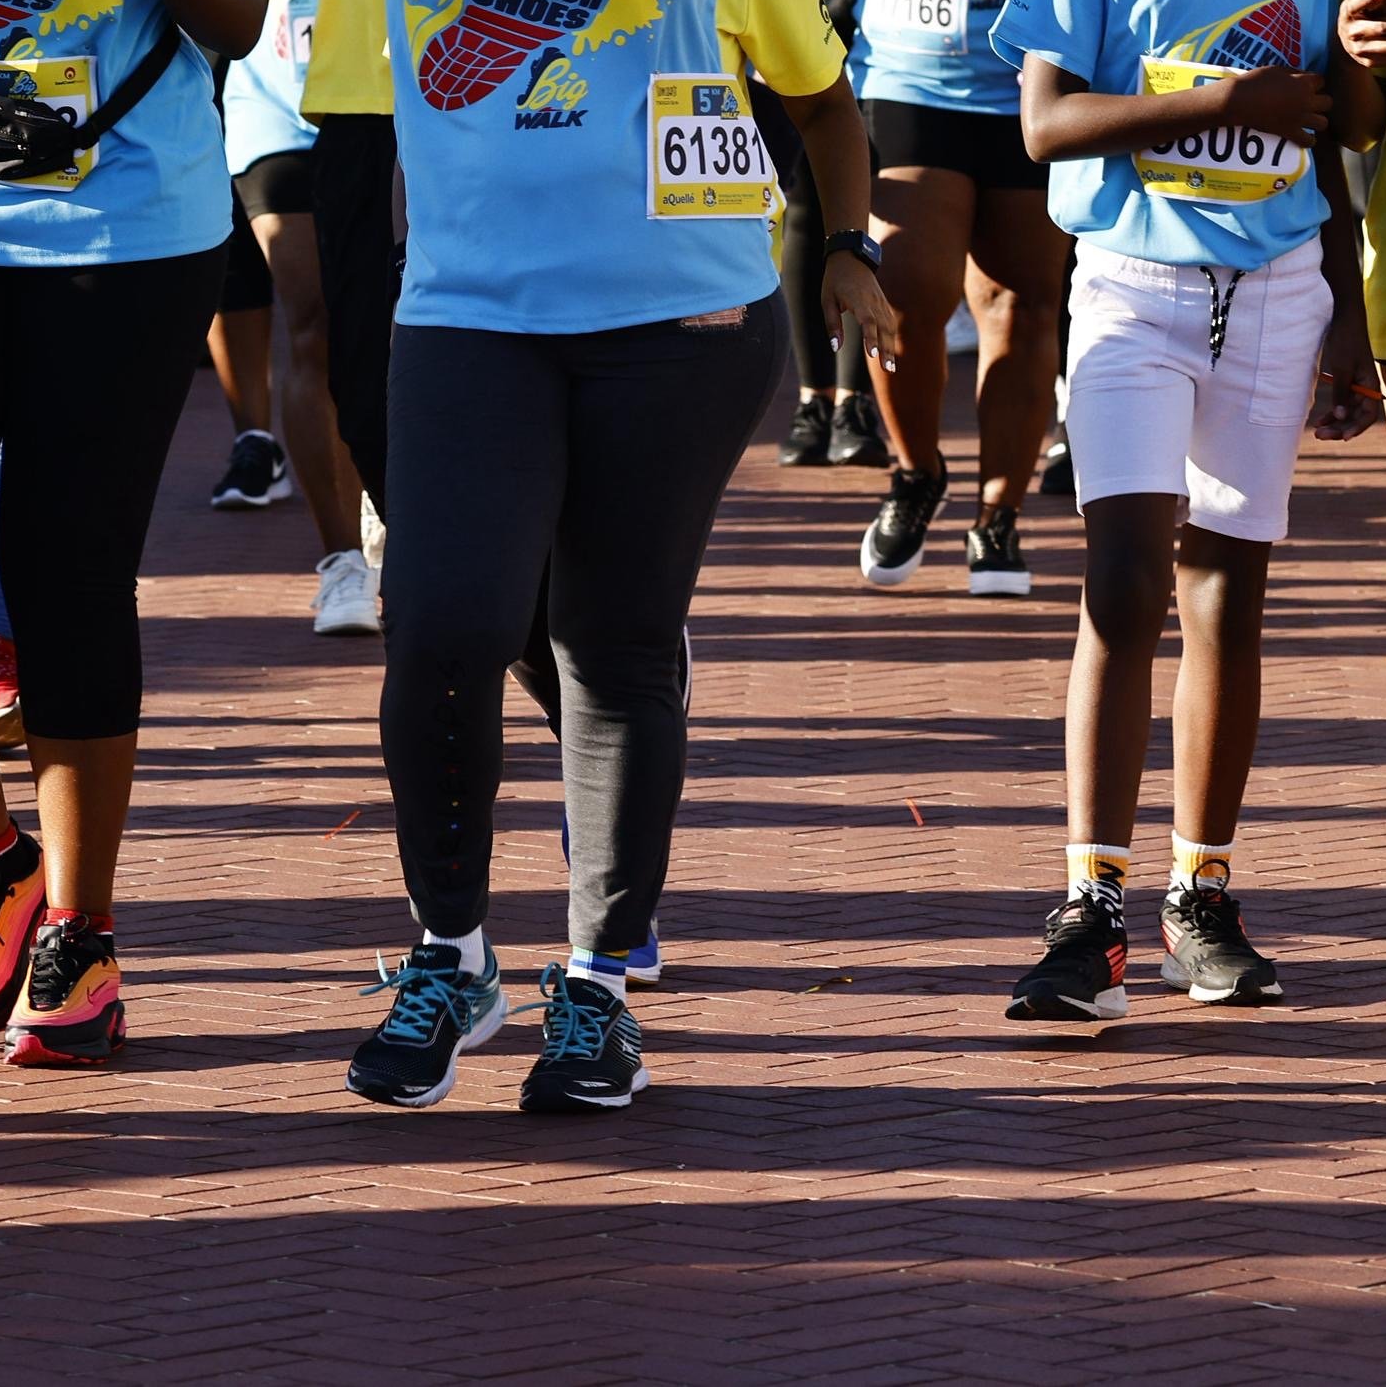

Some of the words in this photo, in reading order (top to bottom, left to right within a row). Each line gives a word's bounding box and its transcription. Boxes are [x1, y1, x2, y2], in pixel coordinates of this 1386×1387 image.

[519, 58, 588, 110] Big
[699, 88, 711, 112] 5
[514, 110, 589, 130] WALK
[664, 126, 766, 175] 61381
